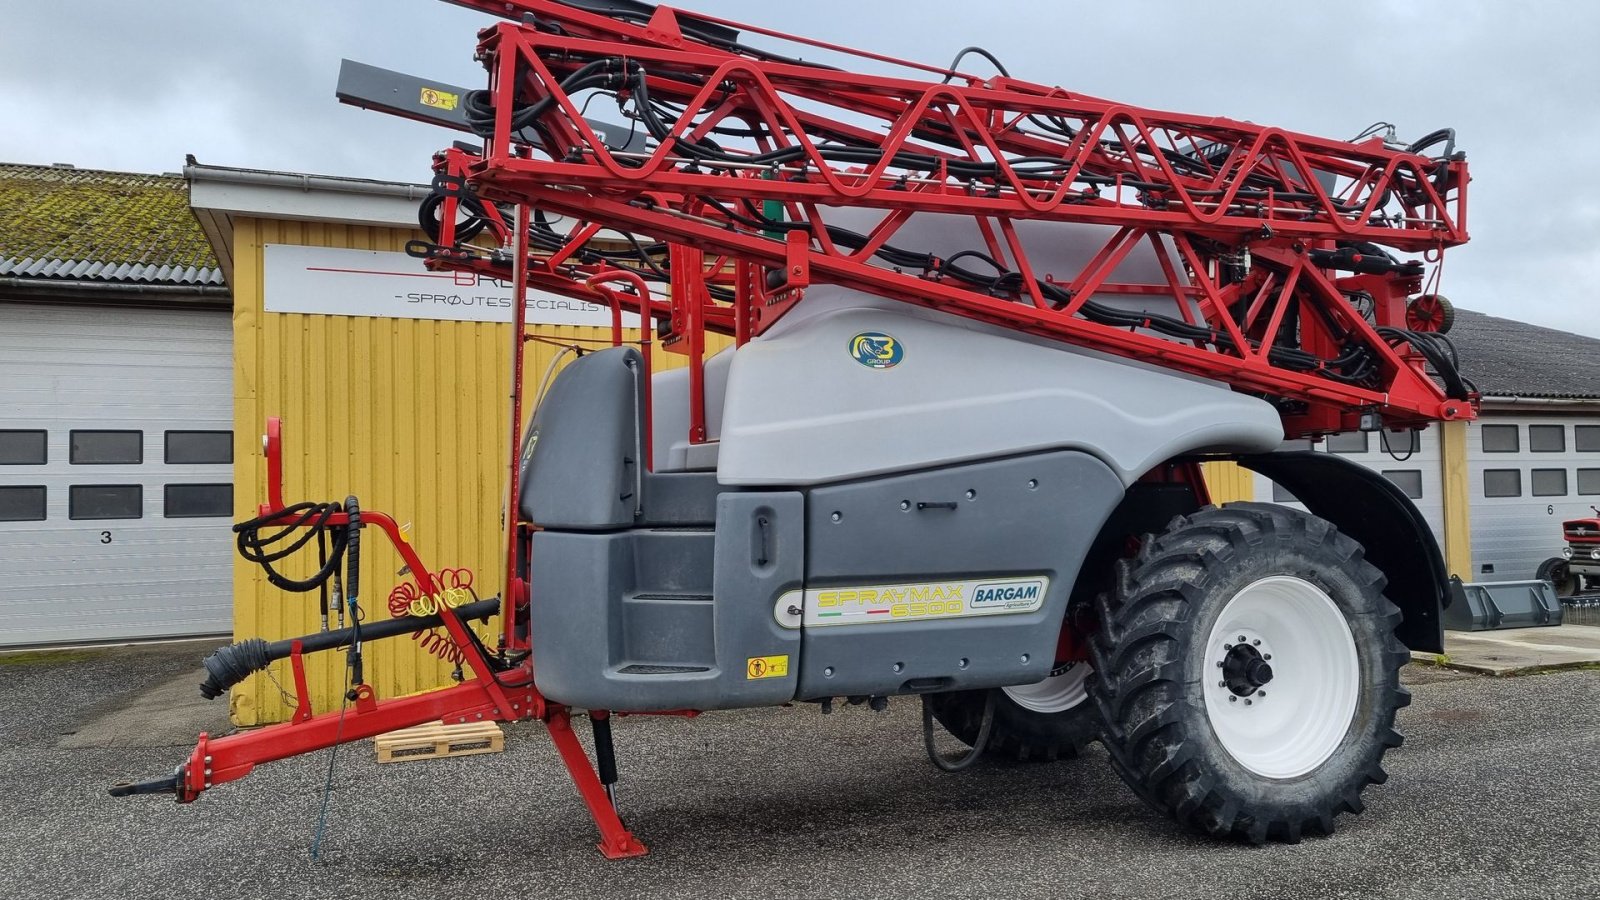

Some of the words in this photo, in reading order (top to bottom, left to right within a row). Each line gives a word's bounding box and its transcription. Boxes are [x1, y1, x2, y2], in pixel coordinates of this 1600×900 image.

[1547, 504, 1554, 515] 6
[100, 530, 112, 544] 3
[817, 584, 963, 607] SPRAYMAX
[975, 586, 1037, 602] BARGAM
[890, 599, 963, 618] 6500
